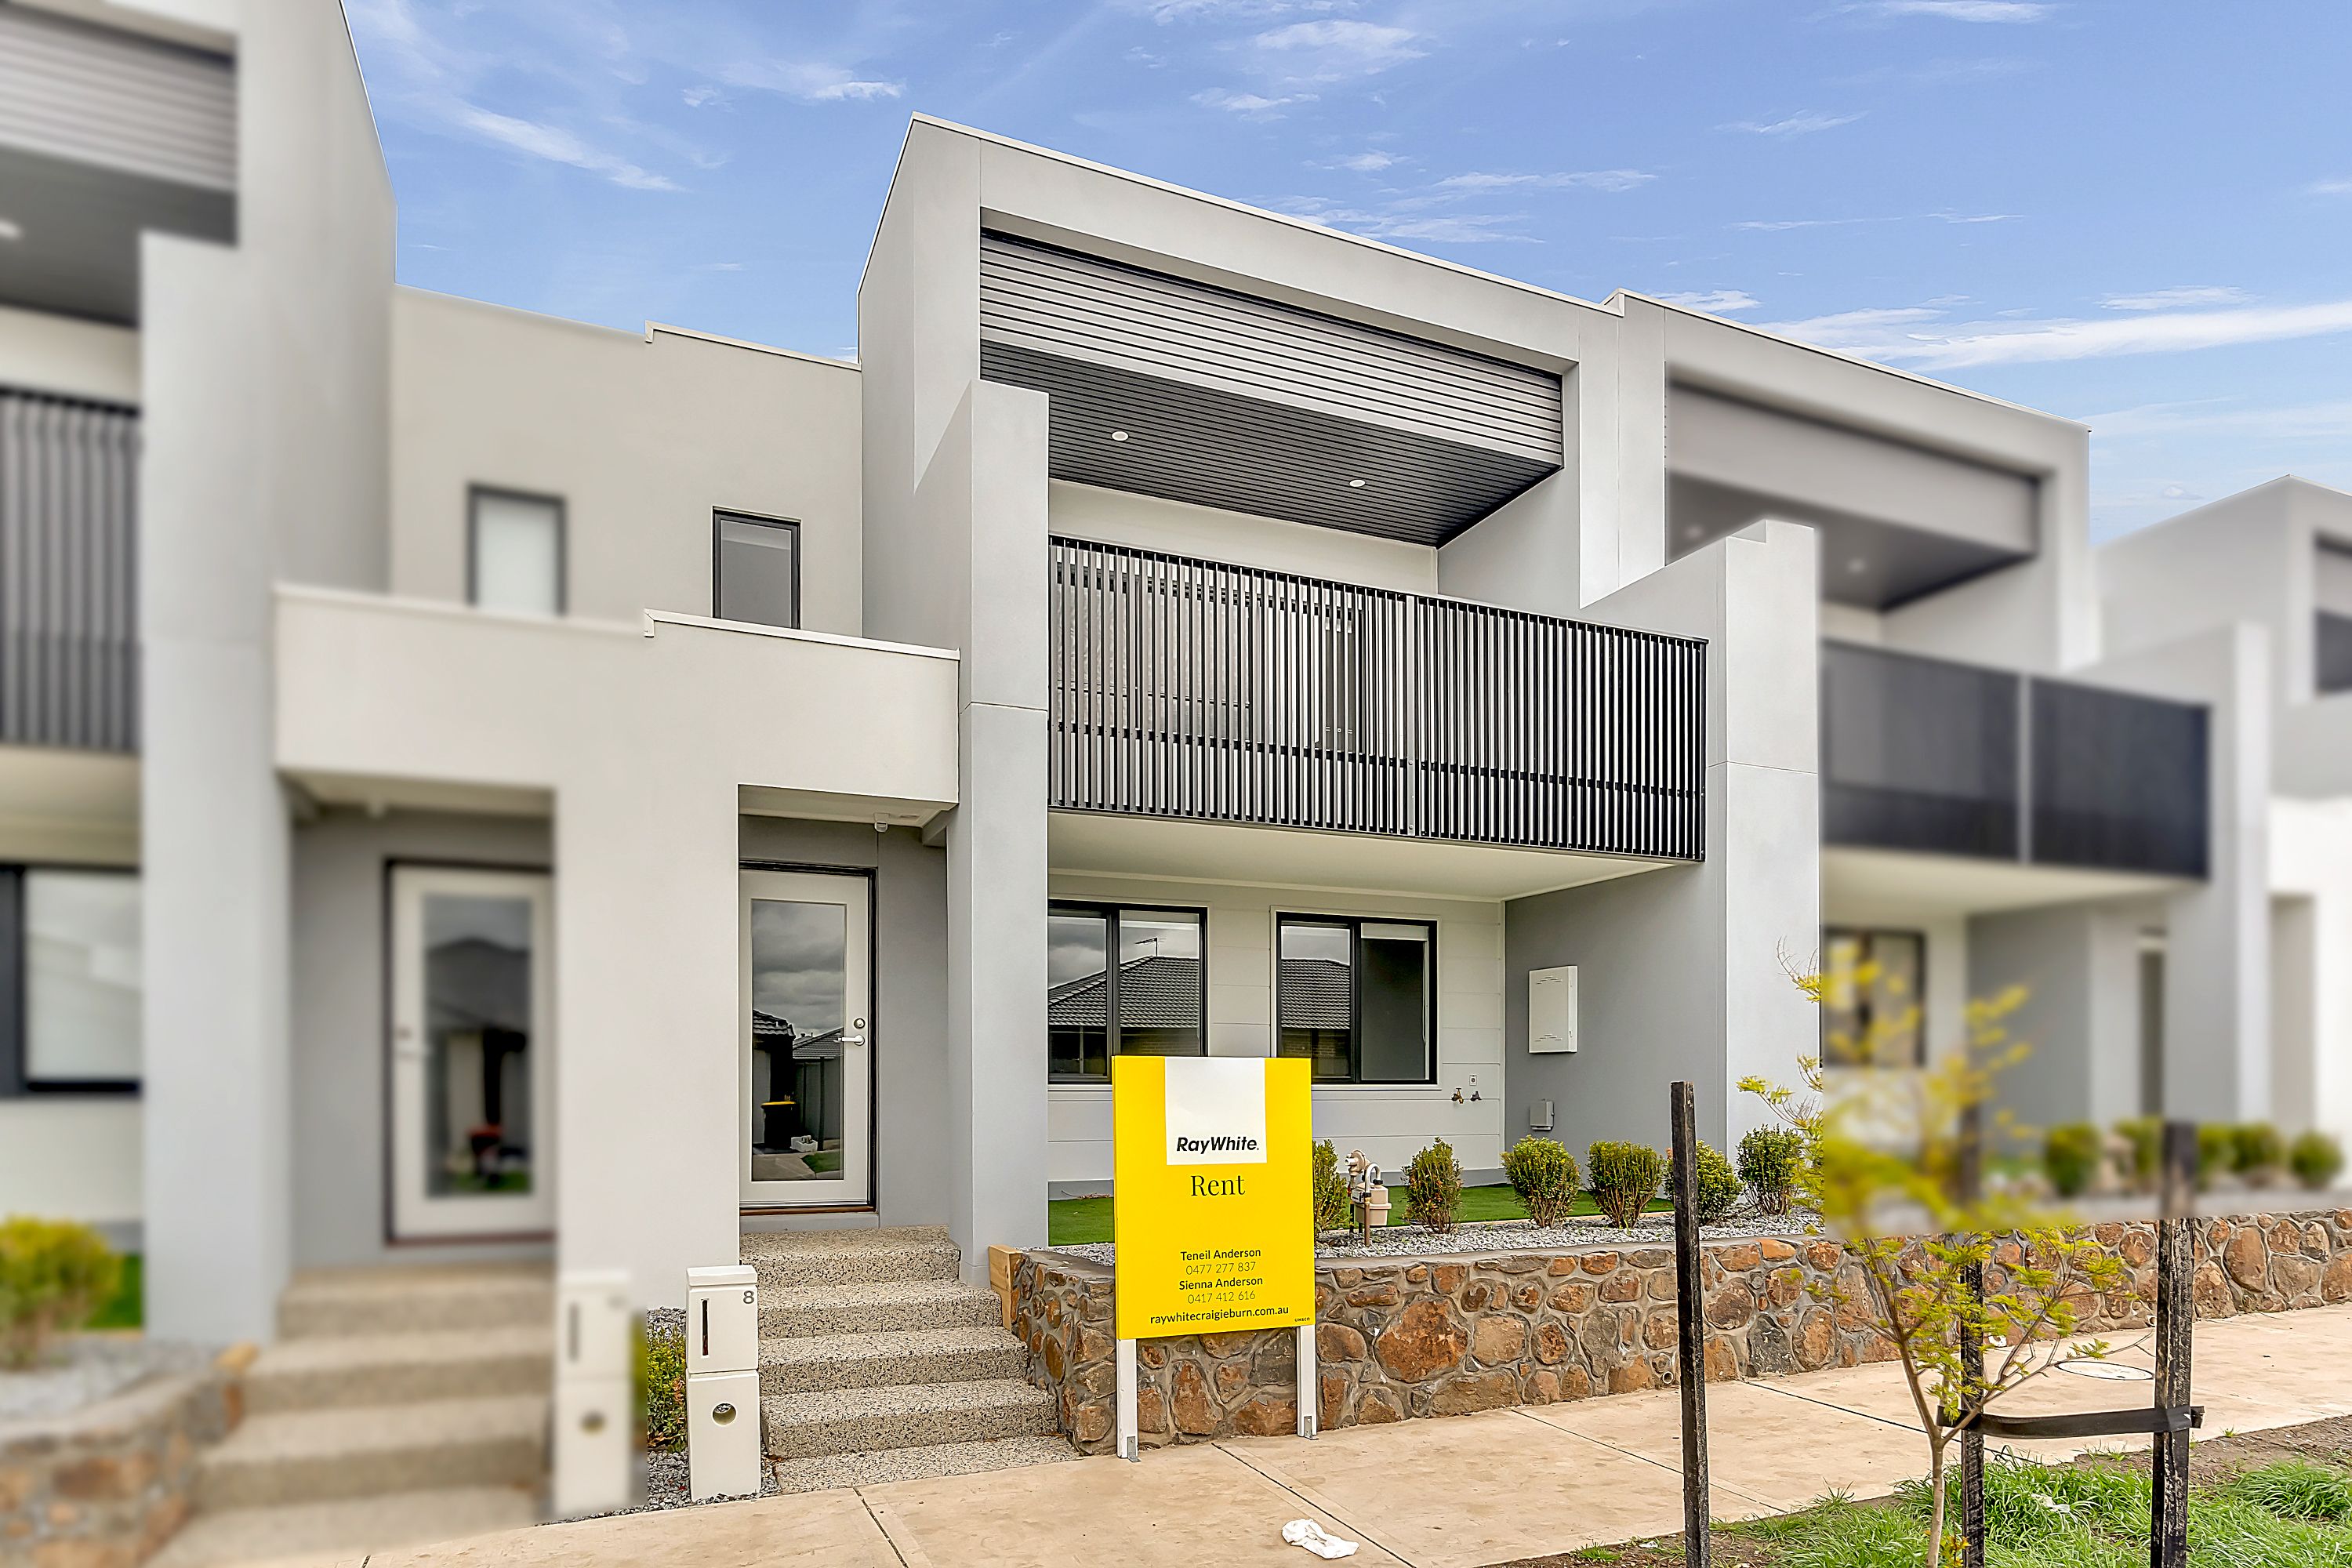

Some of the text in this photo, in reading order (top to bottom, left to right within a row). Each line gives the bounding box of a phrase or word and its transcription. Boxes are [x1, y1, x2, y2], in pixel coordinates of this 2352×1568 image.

[1191, 1175, 1245, 1196] Rent
[1180, 1249, 1261, 1261] Teneil Anderson
[1185, 1261, 1256, 1275] 0477 277 837
[1179, 1277, 1263, 1290] Sienna Anderson
[743, 1290, 755, 1304] 8
[1187, 1290, 1256, 1304] 0417 412 616
[1150, 1307, 1289, 1325] raywhitecraigieburn.com.au
